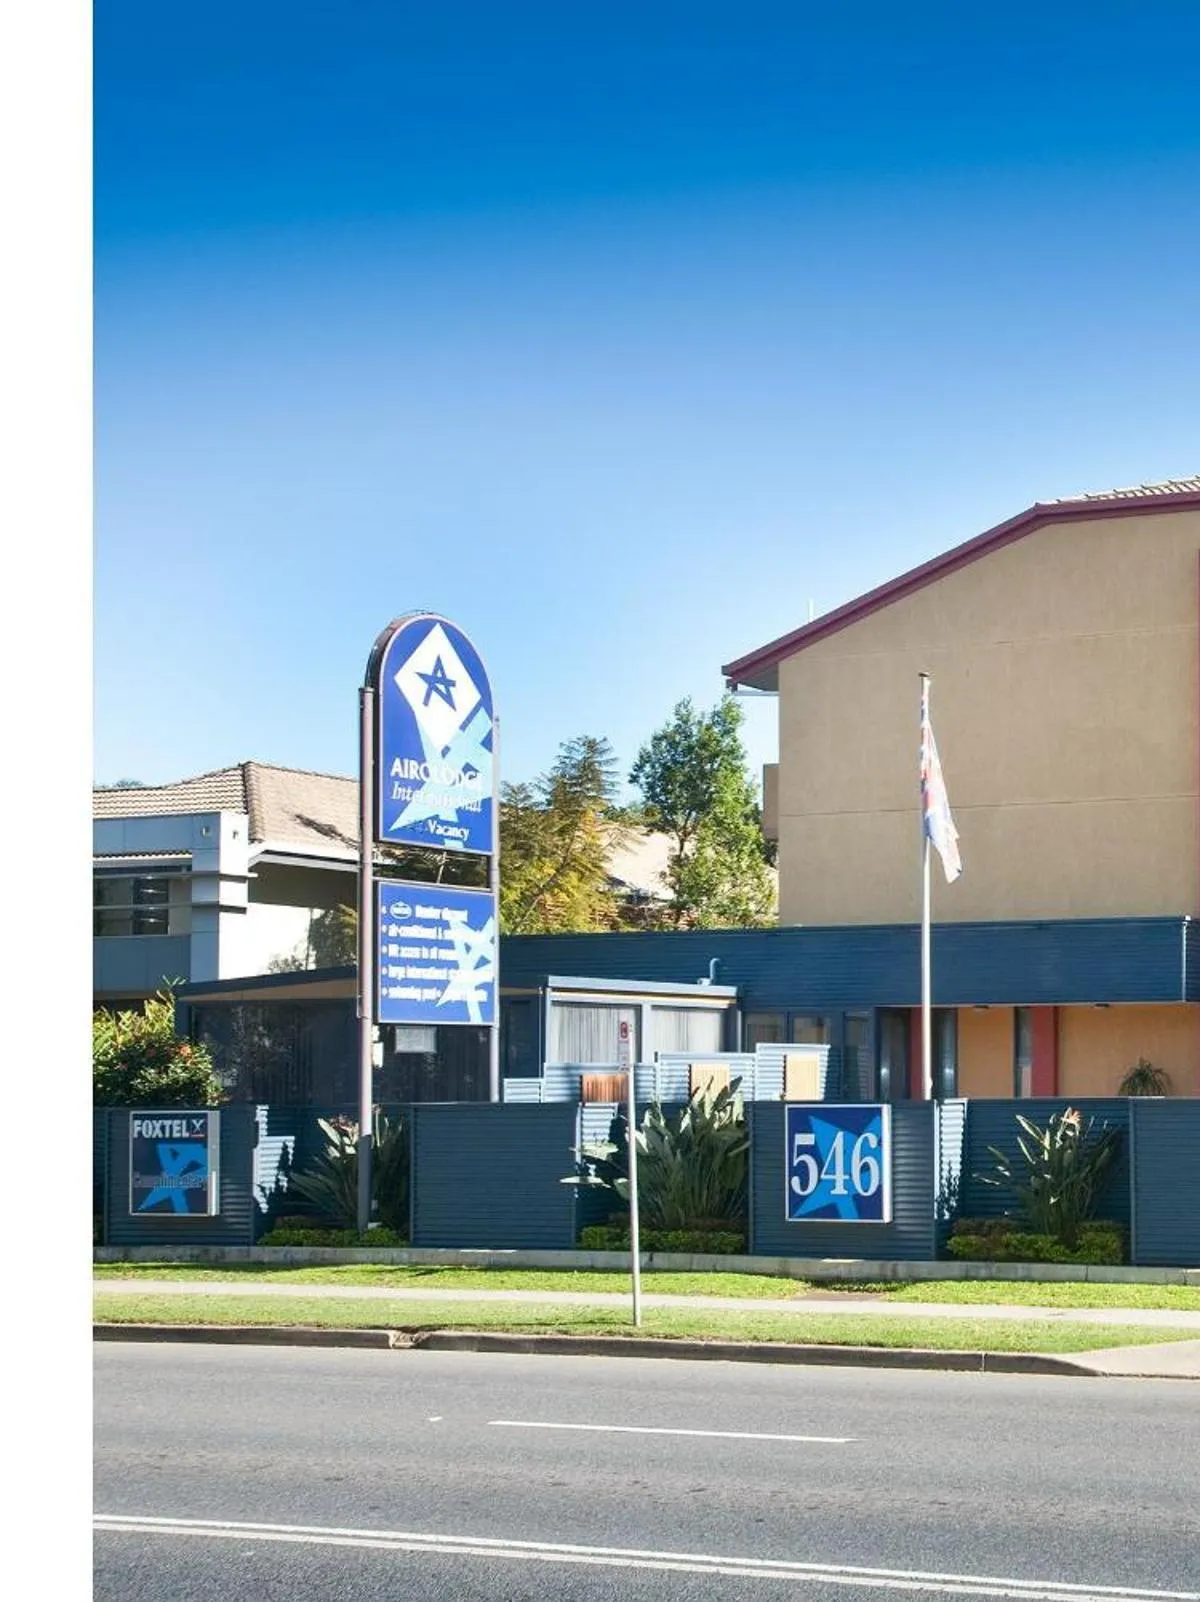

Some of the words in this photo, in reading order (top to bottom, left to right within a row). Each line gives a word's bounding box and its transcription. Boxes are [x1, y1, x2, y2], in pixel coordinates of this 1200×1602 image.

[428, 819, 470, 841] Vacancy
[133, 1120, 189, 1138] FOXTEL
[790, 1131, 880, 1196] 546
